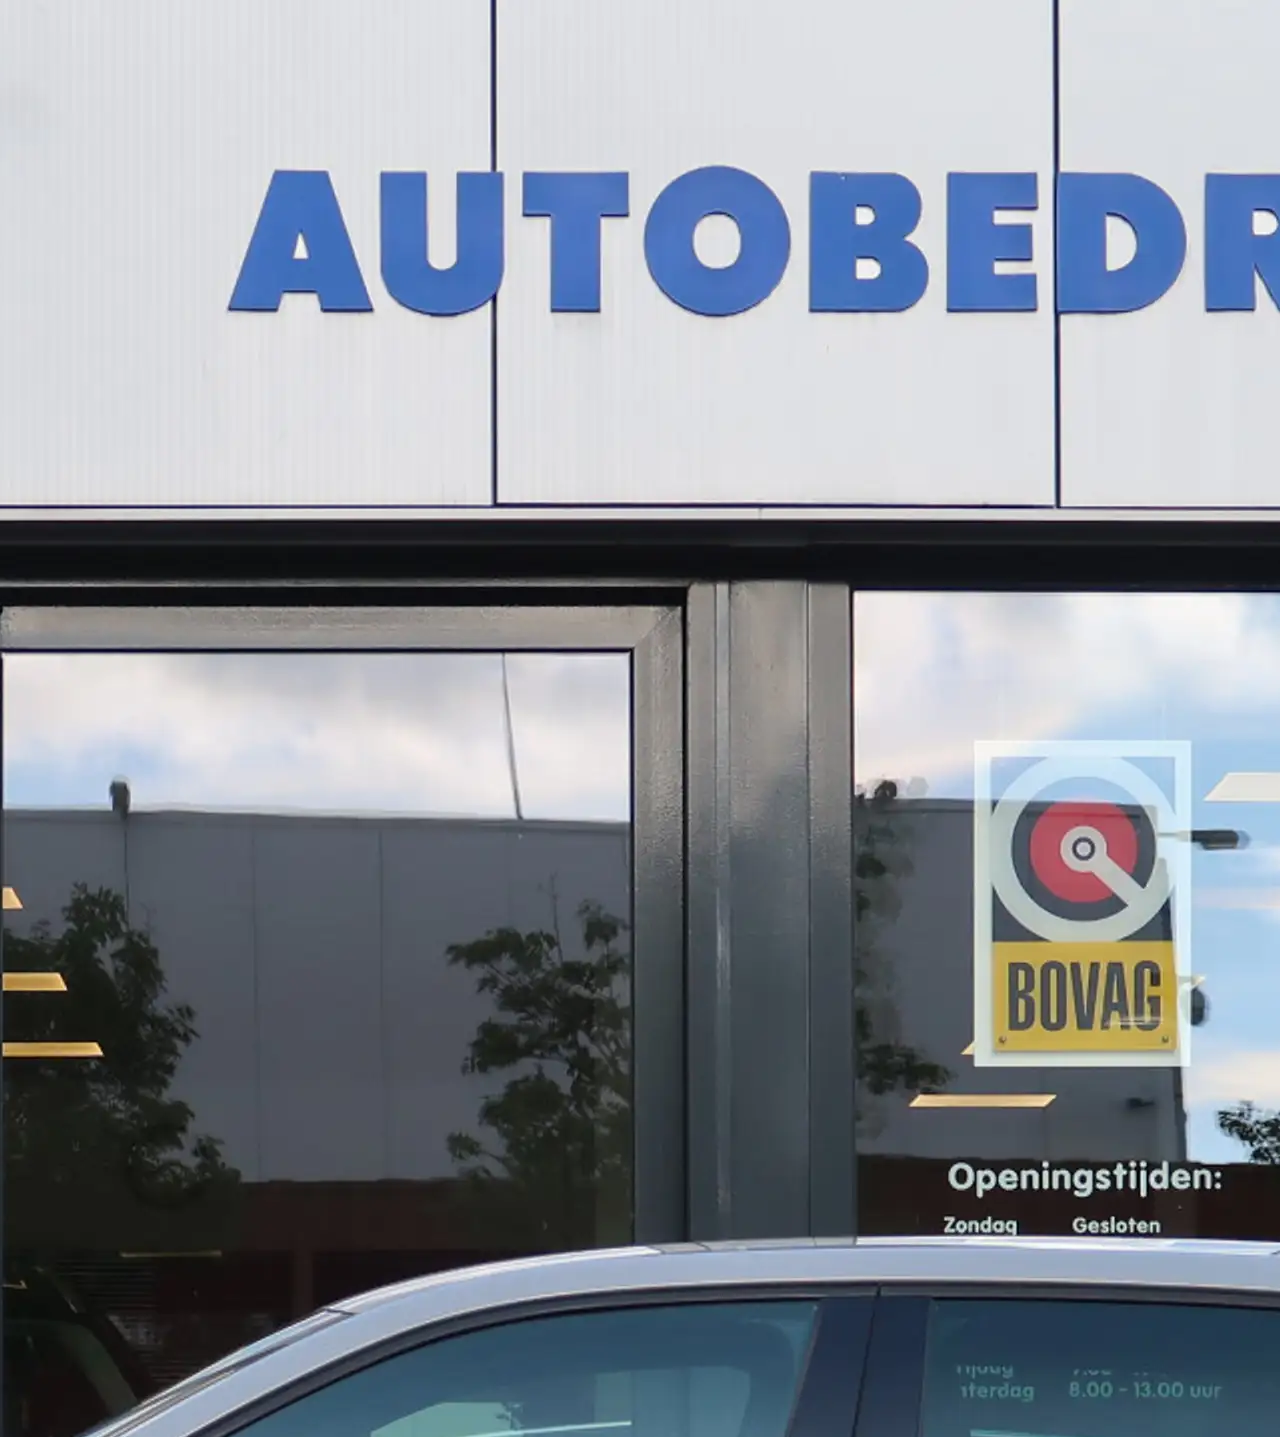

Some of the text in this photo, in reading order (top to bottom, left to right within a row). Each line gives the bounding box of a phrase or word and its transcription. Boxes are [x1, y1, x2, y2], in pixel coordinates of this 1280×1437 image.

[1007, 960, 1161, 1031] BOVAG
[947, 1161, 1222, 1198] Openingstijden:
[1072, 1216, 1161, 1234] Gesloten
[1069, 1381, 1113, 1398] 8.00
[1133, 1381, 1184, 1398] 13.00
[1190, 1384, 1222, 1398] uur
